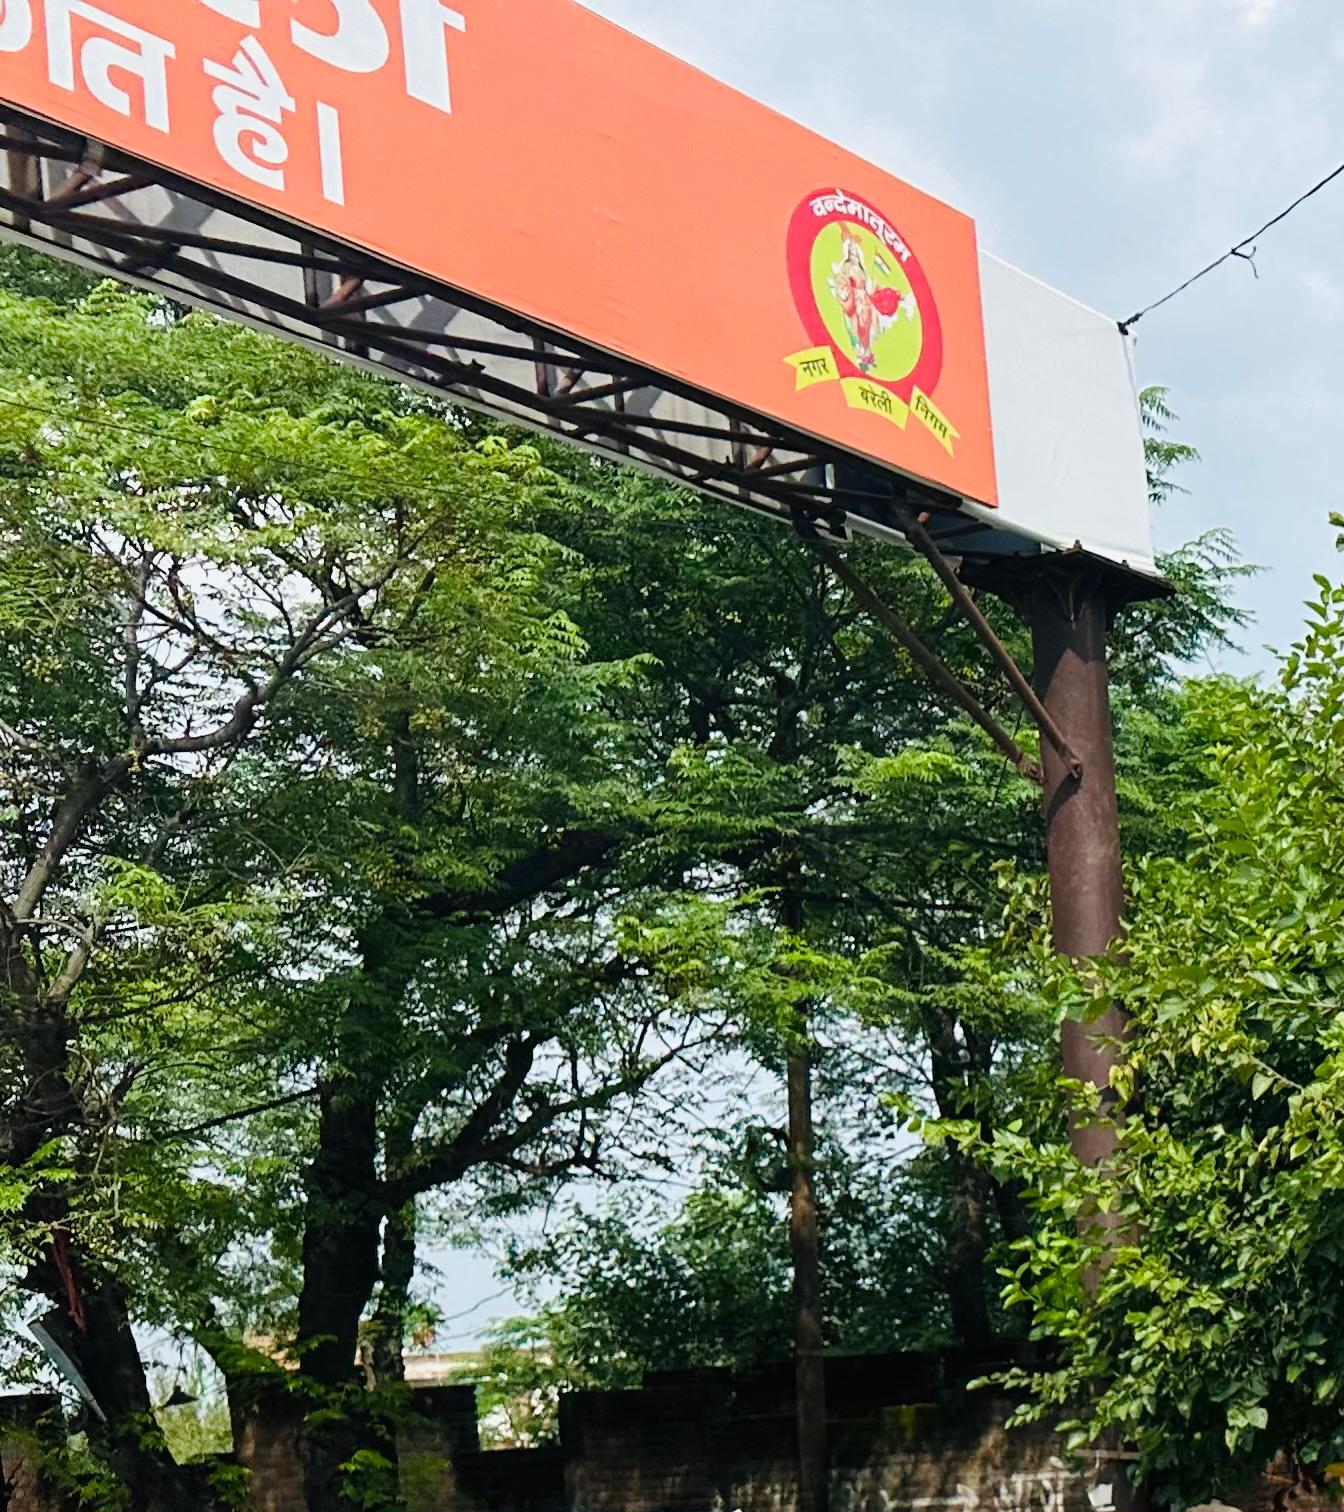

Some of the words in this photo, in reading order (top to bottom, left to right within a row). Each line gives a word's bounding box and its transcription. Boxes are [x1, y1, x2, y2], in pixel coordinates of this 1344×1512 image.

[799, 358, 830, 377] नगर
[859, 386, 893, 414] बरेली
[915, 395, 949, 438] निगम
